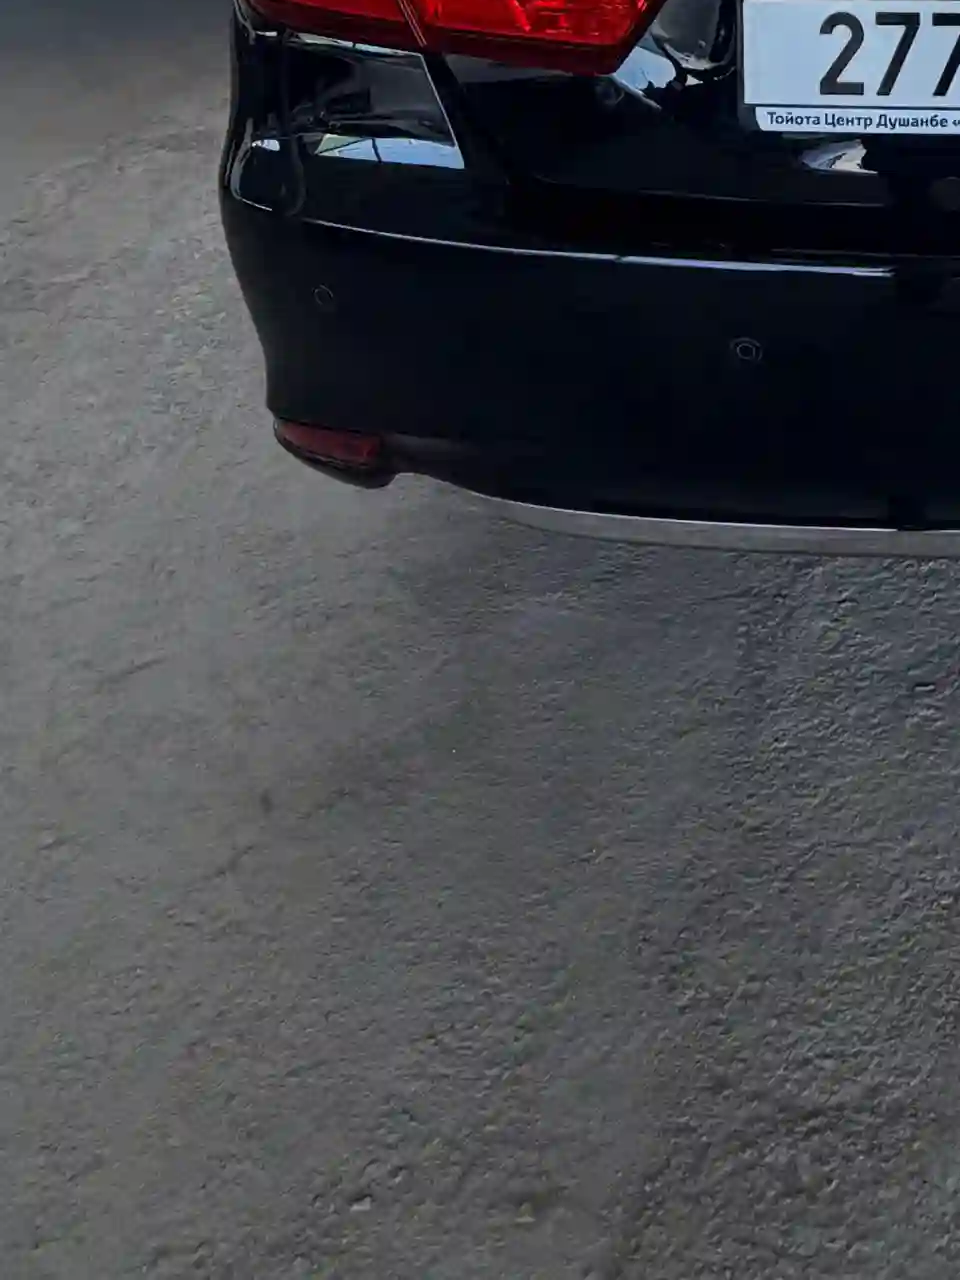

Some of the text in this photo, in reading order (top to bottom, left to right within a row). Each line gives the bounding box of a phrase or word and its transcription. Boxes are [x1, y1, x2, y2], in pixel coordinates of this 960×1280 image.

[767, 112, 821, 125] Тойота
[824, 113, 873, 129] Центр
[876, 114, 949, 131] Душанбе
